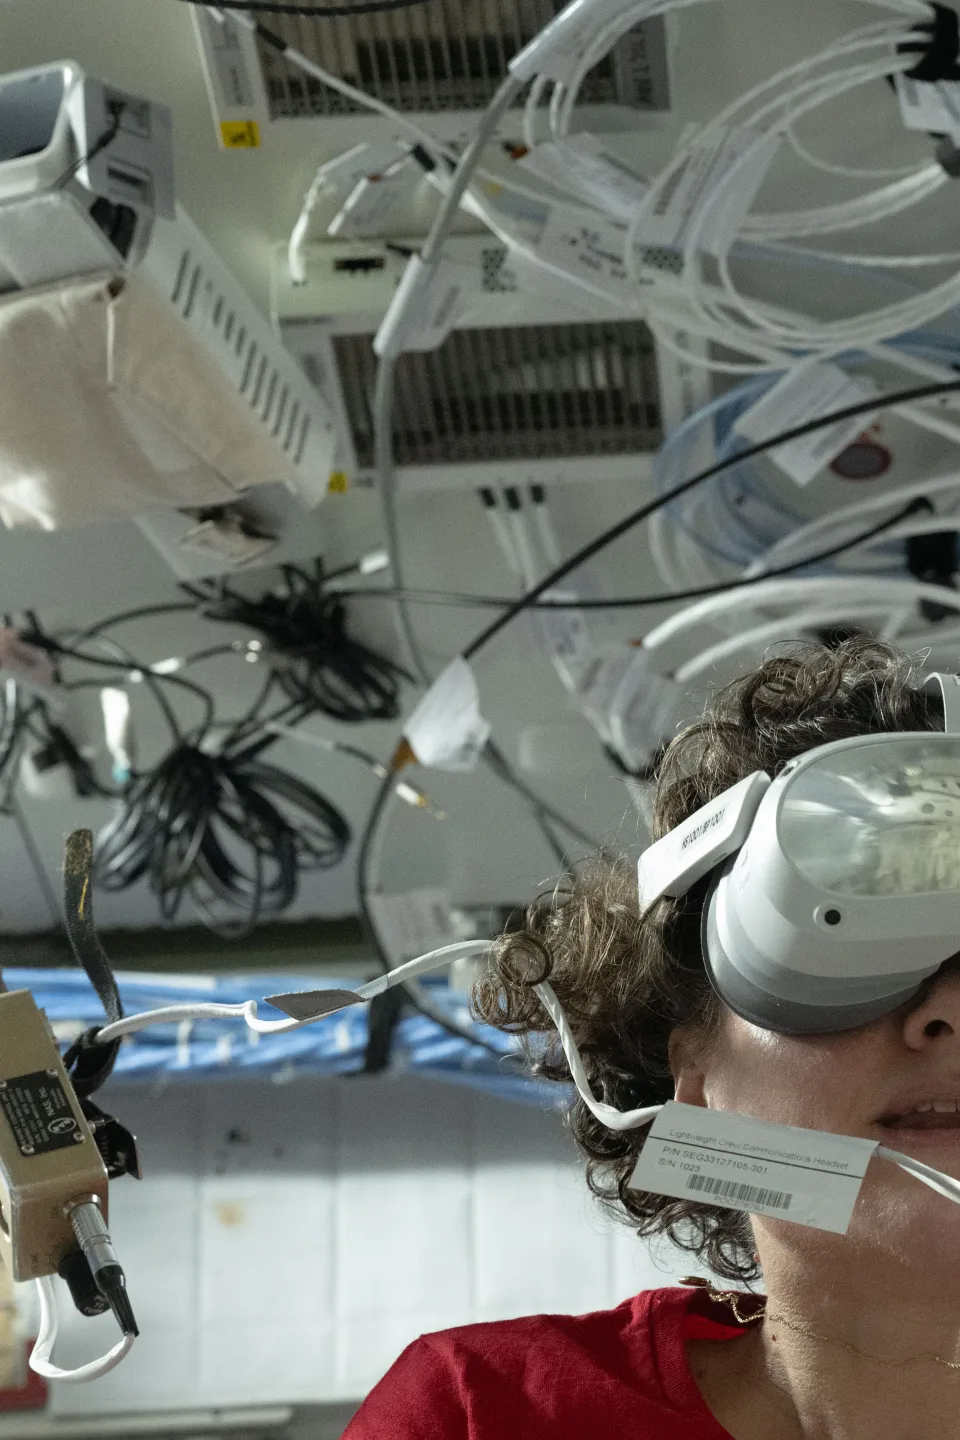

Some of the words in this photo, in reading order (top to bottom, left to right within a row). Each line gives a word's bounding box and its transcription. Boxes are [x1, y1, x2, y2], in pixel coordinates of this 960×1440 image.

[42, 1100, 55, 1117] NAS
[661, 1146, 681, 1156] P/N
[682, 1150, 768, 1174] SEG33127105-301
[669, 1129, 717, 1145] Lightweight
[743, 1143, 811, 1163] Communications
[813, 1157, 849, 1171] Headset
[658, 1157, 676, 1168] S/N
[679, 1162, 701, 1173] 1023
